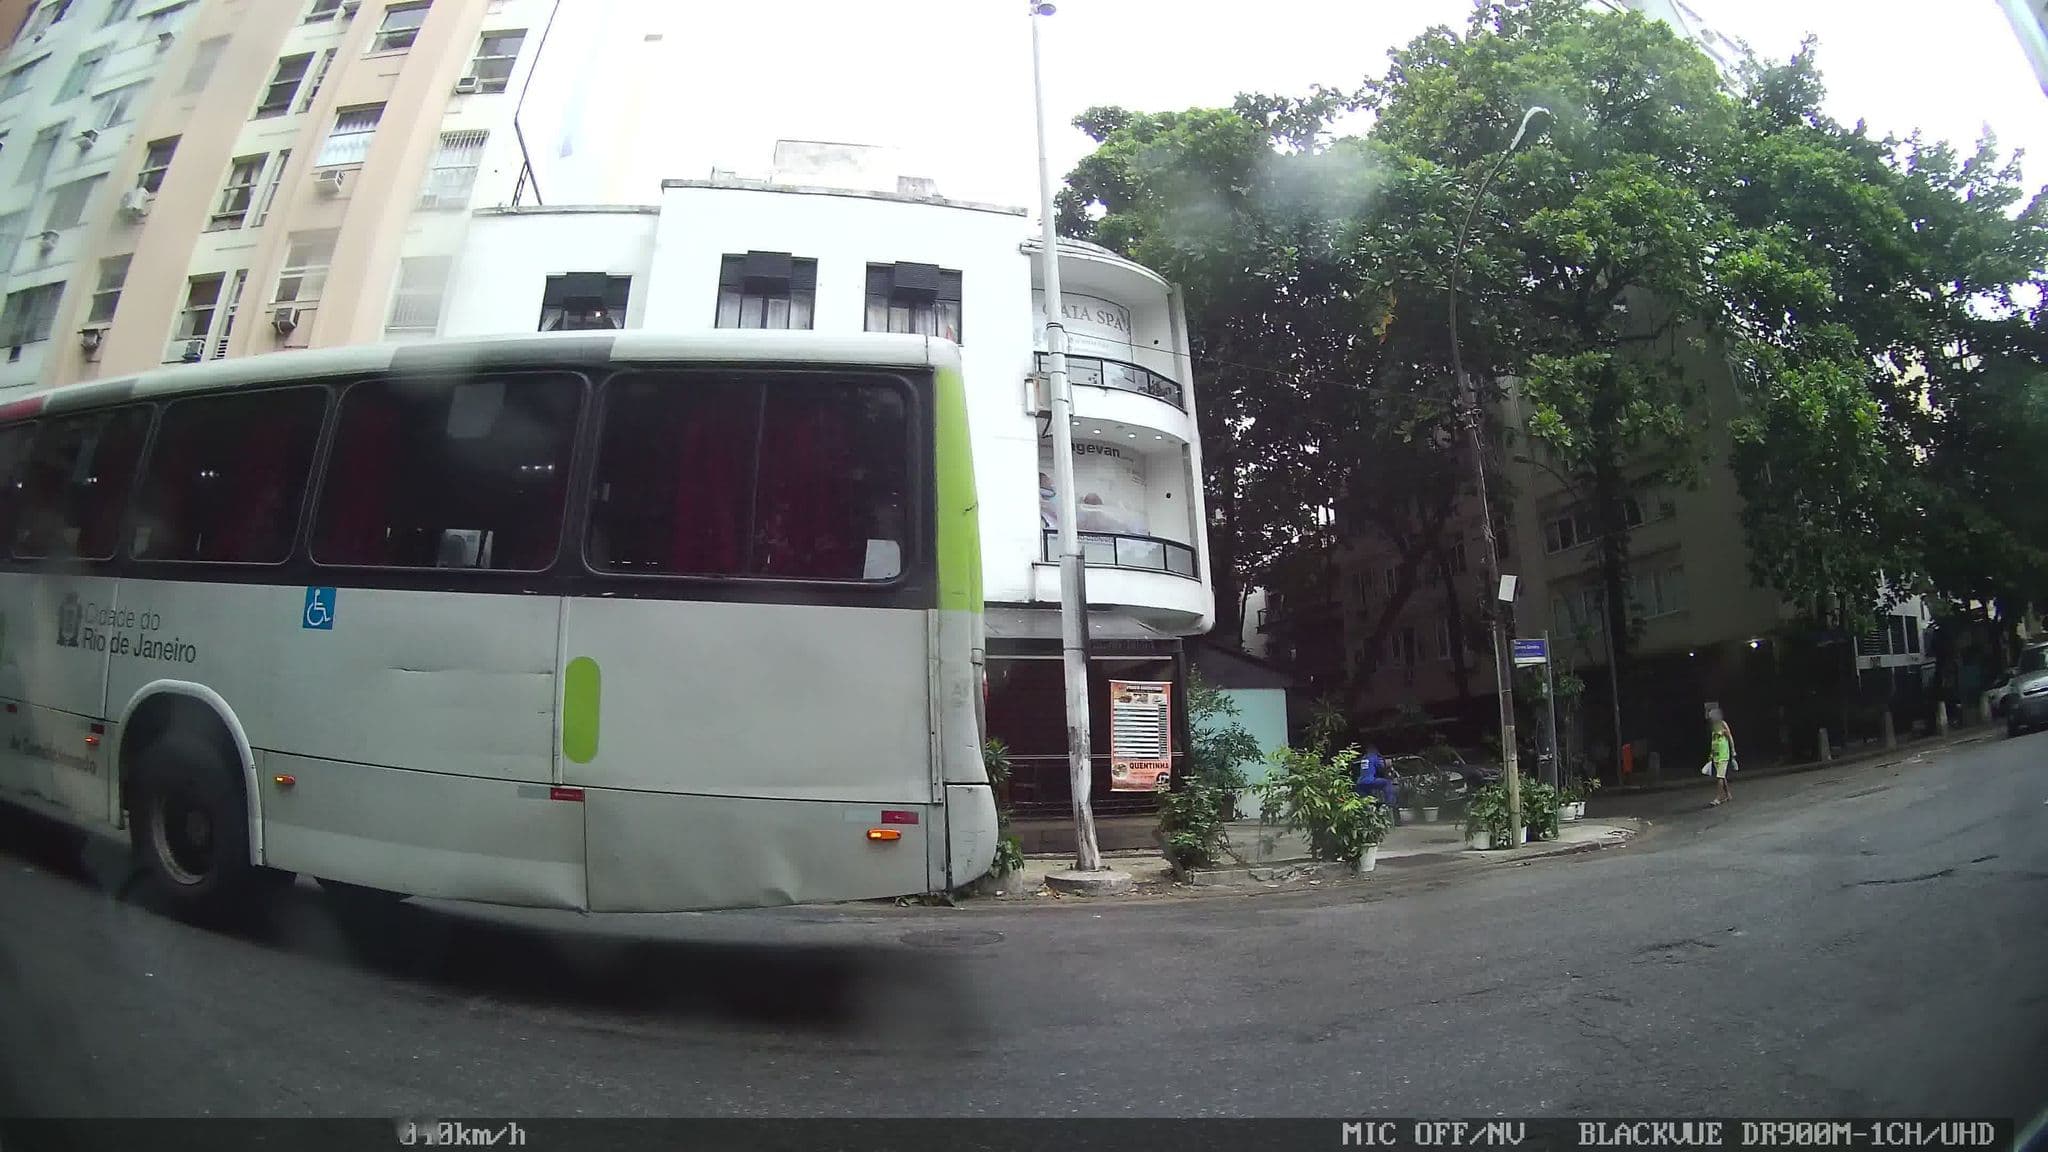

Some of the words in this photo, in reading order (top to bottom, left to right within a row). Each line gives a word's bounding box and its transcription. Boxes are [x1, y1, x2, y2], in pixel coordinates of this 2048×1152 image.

[1097, 310, 1124, 332] SPA
[141, 608, 161, 631] do
[83, 627, 106, 652] Rio
[110, 632, 130, 655] de
[133, 633, 196, 663] Janeiro
